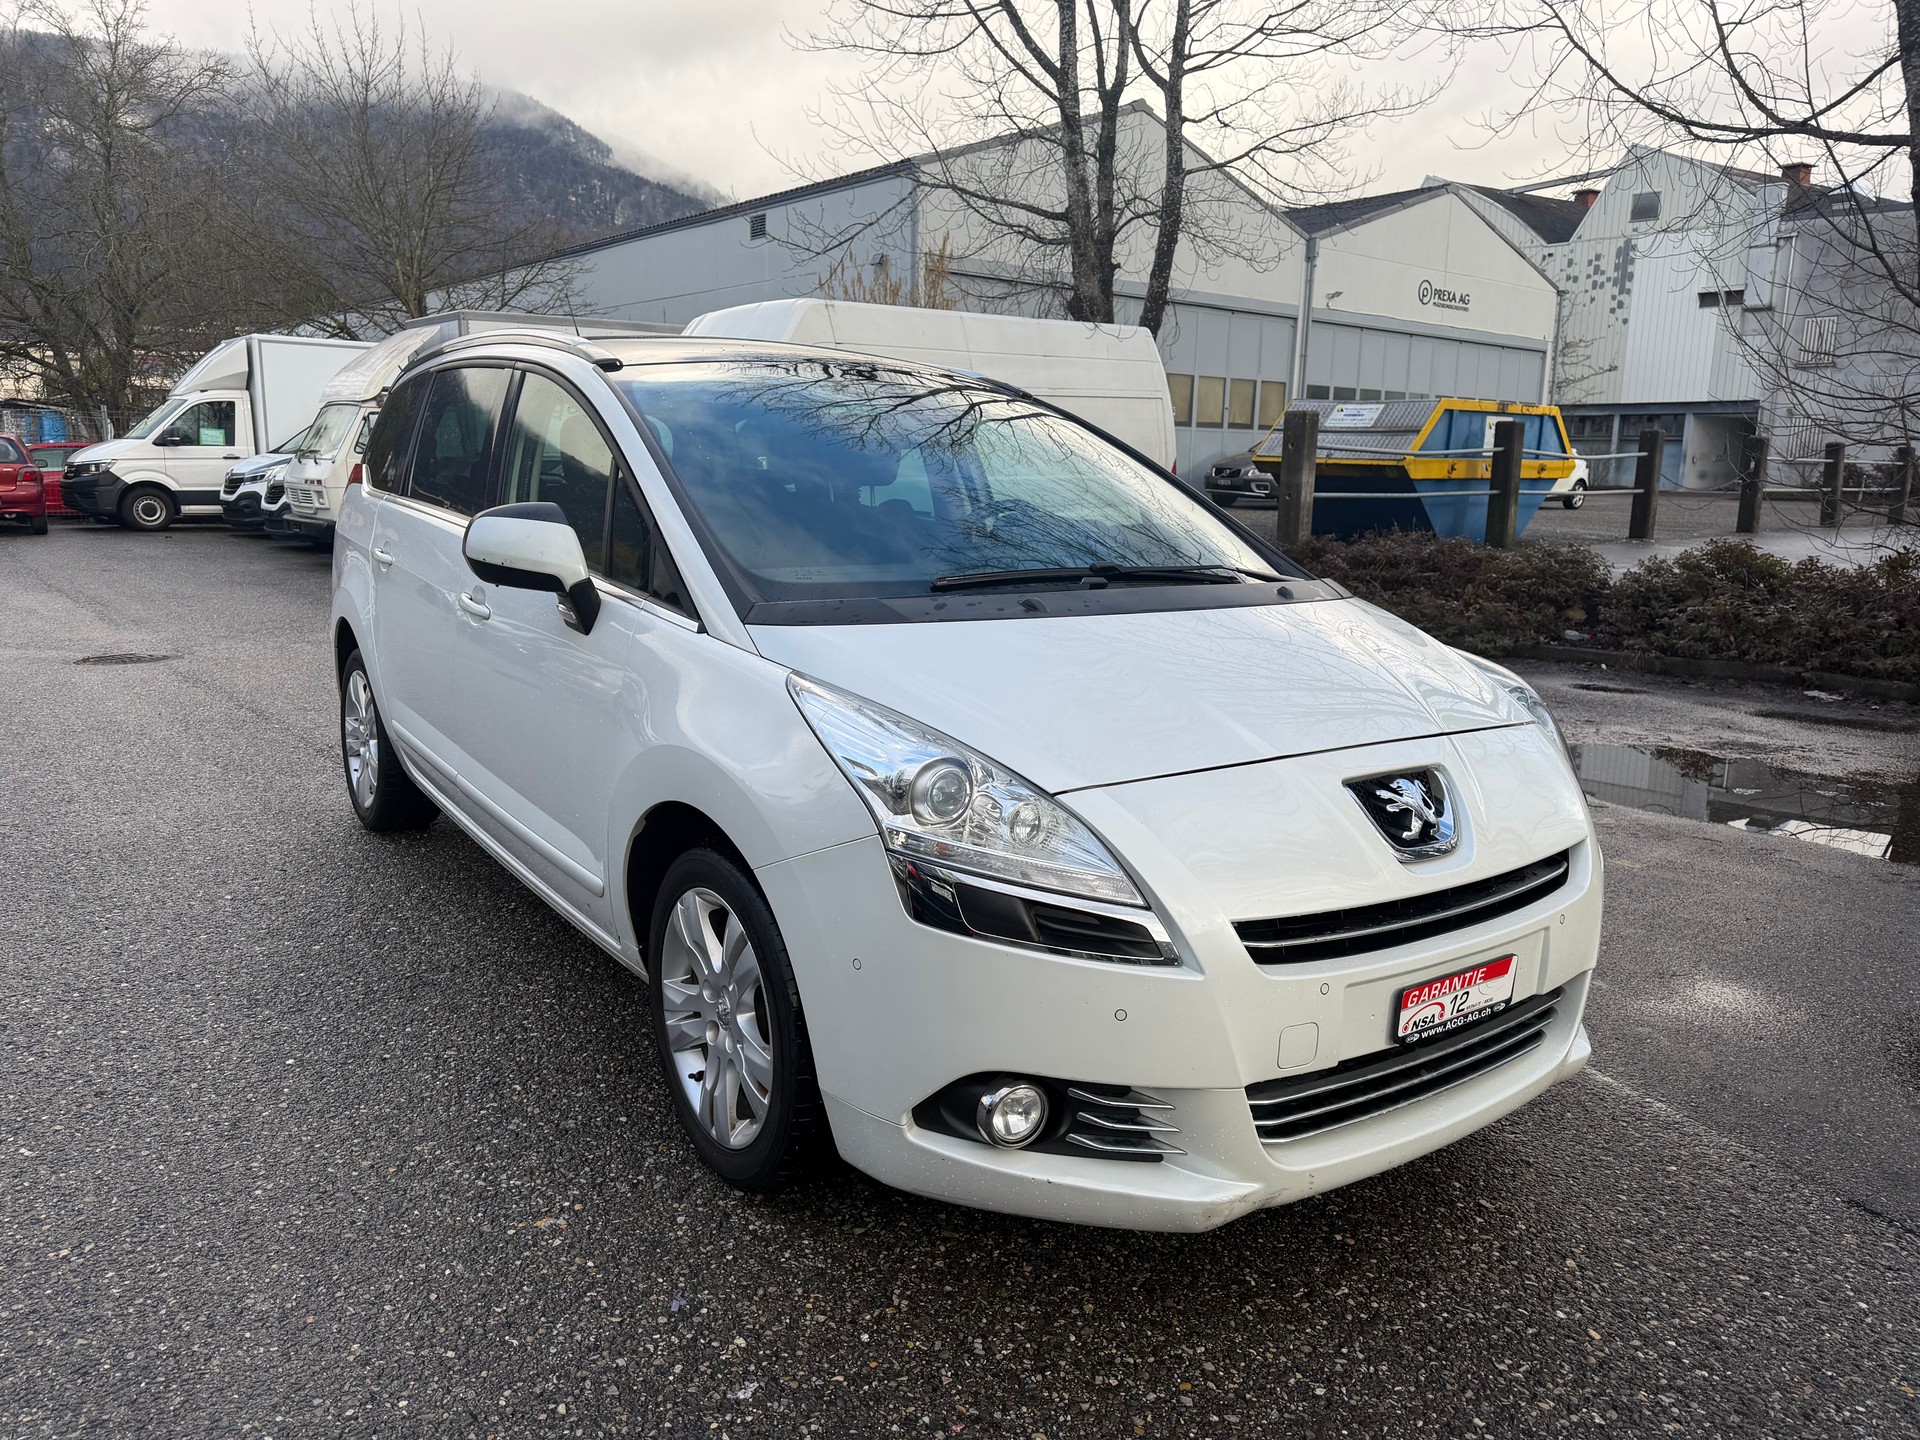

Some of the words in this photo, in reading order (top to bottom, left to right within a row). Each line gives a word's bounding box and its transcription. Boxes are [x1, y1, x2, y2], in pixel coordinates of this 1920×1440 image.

[1433, 288, 1457, 303] PREXA
[1458, 292, 1471, 305] AG
[1407, 967, 1487, 1008] GARANTIE
[1449, 990, 1470, 1016] 12
[1410, 1013, 1436, 1032] NSA
[1421, 1007, 1492, 1039] www.ACG-AG.ch
